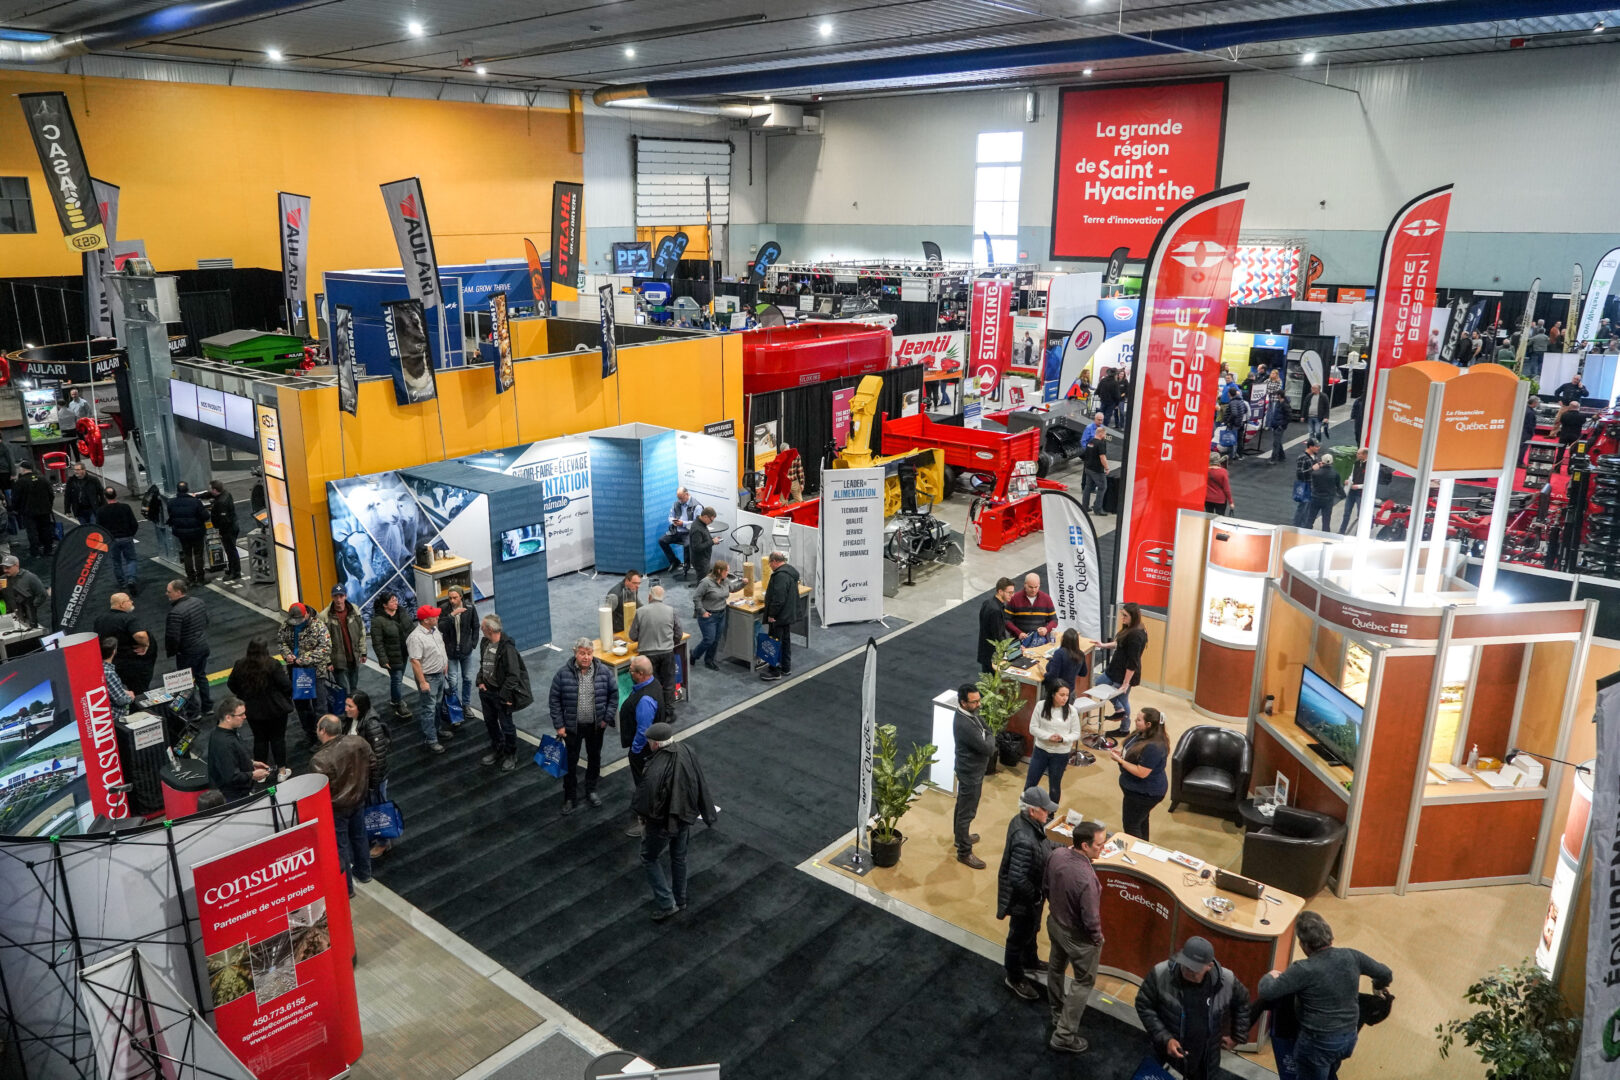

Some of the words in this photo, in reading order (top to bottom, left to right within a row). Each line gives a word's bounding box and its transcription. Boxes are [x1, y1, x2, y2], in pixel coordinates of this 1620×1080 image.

[1096, 122, 1116, 137] La
[1120, 118, 1183, 140] grande
[1114, 140, 1169, 160] région
[1075, 158, 1096, 173] de
[1098, 159, 1154, 179] Saint
[1084, 180, 1196, 205] Hyacinthe
[1083, 215, 1105, 224] Terre
[1107, 215, 1164, 225] d'innovation
[558, 191, 572, 278] STRAHL
[286, 224, 300, 291] AULARI
[403, 217, 434, 296] AULARI
[1392, 260, 1417, 359] GRÉGOIRE
[1408, 260, 1430, 341] BESSON
[383, 306, 398, 357] SERVAL
[982, 285, 999, 360] SILOKING
[1441, 296, 1470, 361] EKIPEX
[895, 335, 952, 356] Jeantil
[27, 363, 67, 375] AULARI
[95, 357, 120, 374] AULARI
[1182, 307, 1211, 435] BESSON
[1160, 306, 1191, 461] GRÉGOIRE
[1393, 411, 1414, 427] Québec
[1455, 421, 1489, 432] Québec
[558, 455, 588, 474] ÉLEVAGE
[833, 488, 877, 499] ALIMENTATION
[843, 479, 864, 489] LEADER
[841, 506, 868, 514] TECHNOLOGIE
[845, 516, 863, 525] QUALITÉ
[845, 528, 863, 536] SERVICE
[839, 549, 869, 558] PERFORMANCE
[1074, 548, 1089, 592] Québec
[60, 551, 98, 627] PERMODOME
[1055, 562, 1066, 608] Financière
[1066, 585, 1077, 620] agricole
[1058, 611, 1066, 620] La
[1351, 617, 1389, 633] Québec
[165, 670, 191, 681] CONCOURS
[135, 725, 161, 736] CONCOURS
[213, 907, 257, 931] Partenaire
[259, 902, 270, 912] de
[271, 896, 286, 907] vos
[287, 884, 315, 902] projets
[1119, 889, 1156, 911] Québec
[242, 1001, 319, 1042] agricole@consumaj.com
[252, 996, 306, 1027] 450.773.6155
[249, 1011, 313, 1046] www.consumaj.com
